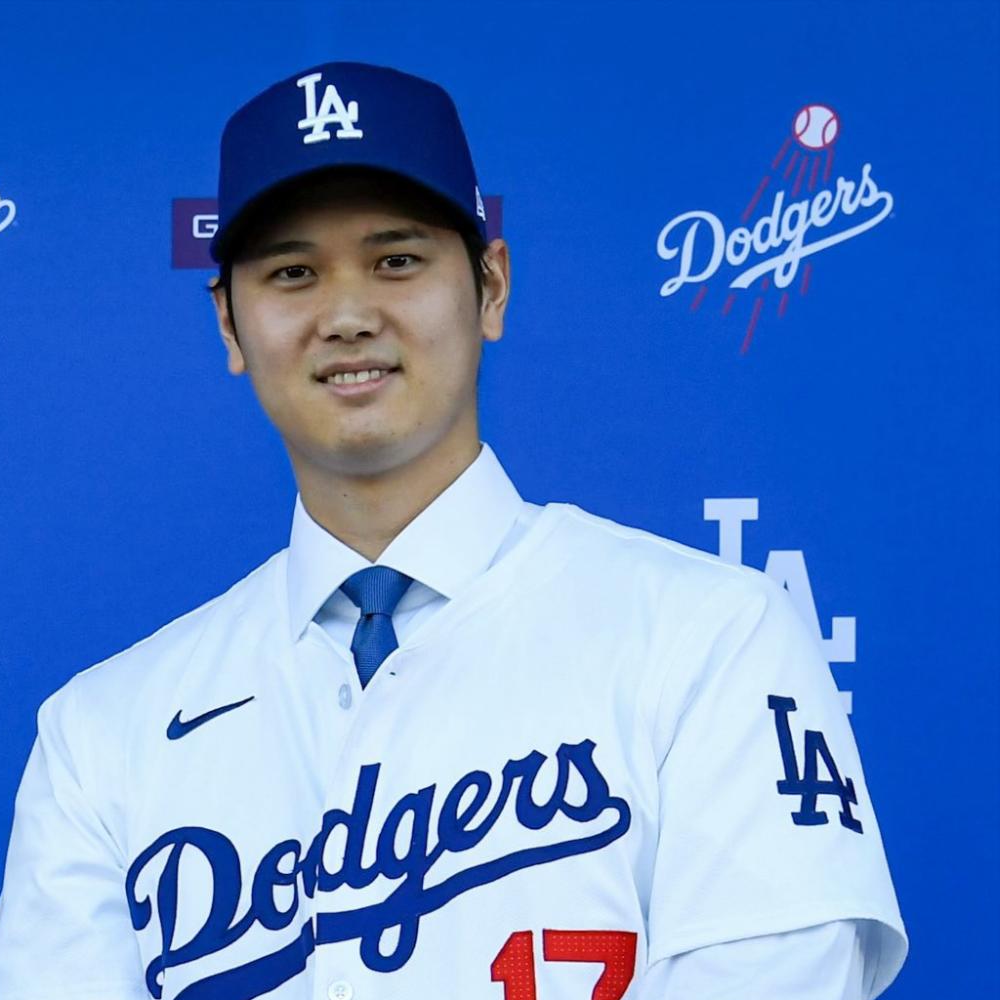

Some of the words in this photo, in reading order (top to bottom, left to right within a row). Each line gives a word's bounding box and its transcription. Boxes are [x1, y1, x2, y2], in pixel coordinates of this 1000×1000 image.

[297, 72, 364, 143] LA
[657, 164, 893, 297] Dodgers
[767, 694, 864, 835] LA
